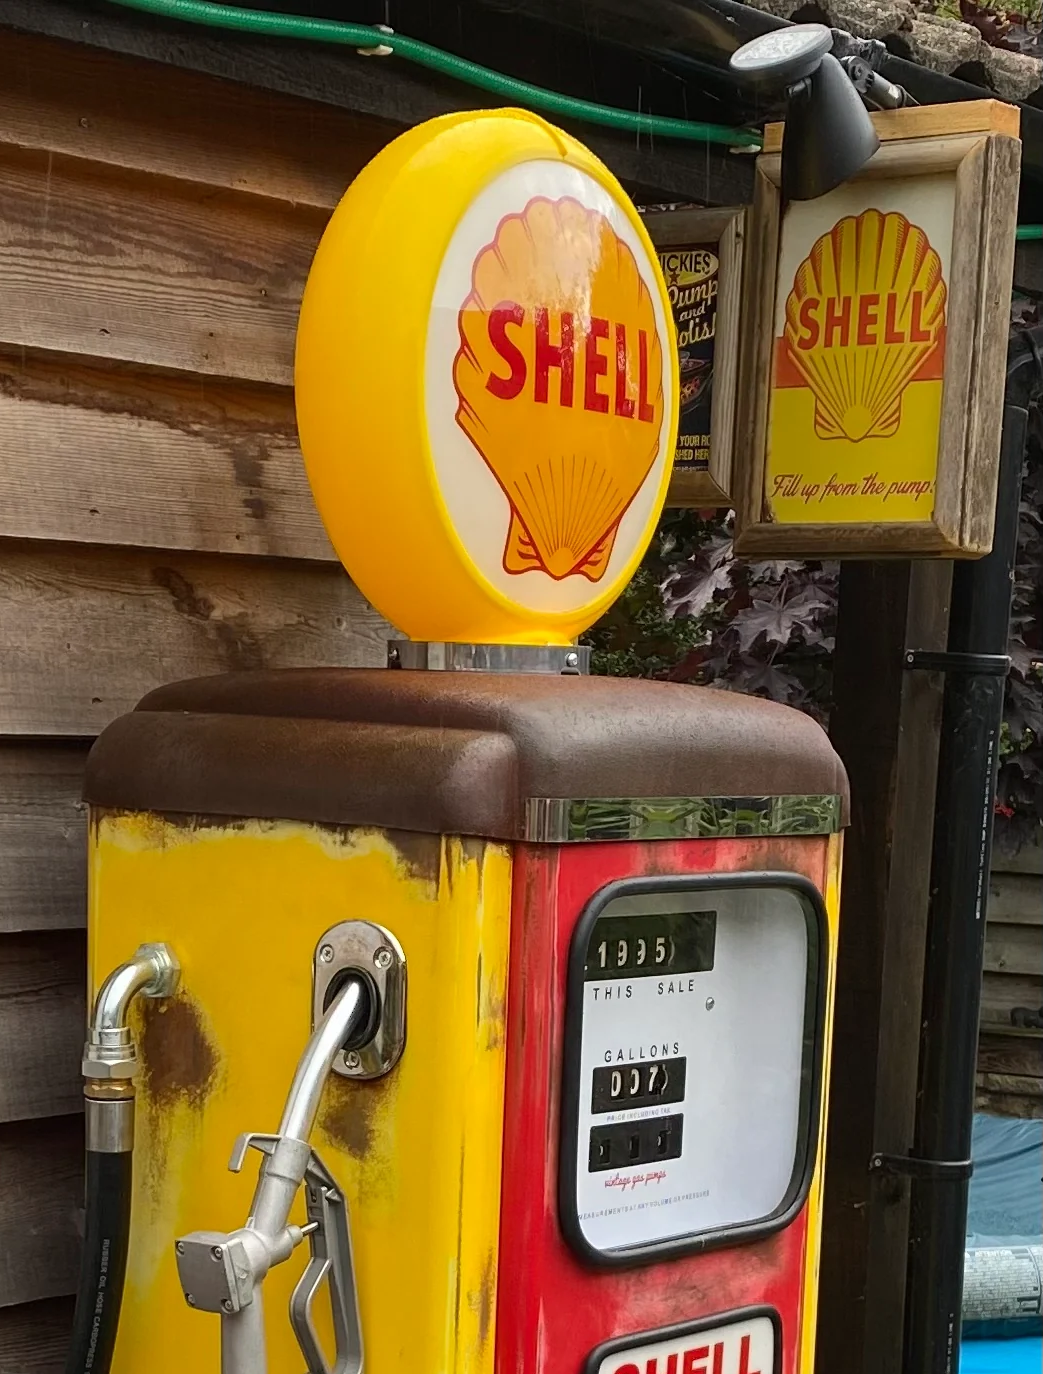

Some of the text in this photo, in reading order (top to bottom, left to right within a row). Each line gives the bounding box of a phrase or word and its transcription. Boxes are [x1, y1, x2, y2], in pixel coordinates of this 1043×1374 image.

[658, 253, 711, 276] ICKIES
[679, 301, 706, 322] and
[797, 291, 931, 350] SHELL
[678, 312, 716, 348] olis
[485, 300, 654, 423] SHELL
[772, 474, 803, 498] Fill
[803, 483, 820, 504] up
[819, 472, 857, 503] from
[861, 472, 885, 495] the
[593, 979, 695, 1001] THIS SALE
[604, 1042, 680, 1063] GALLONS
